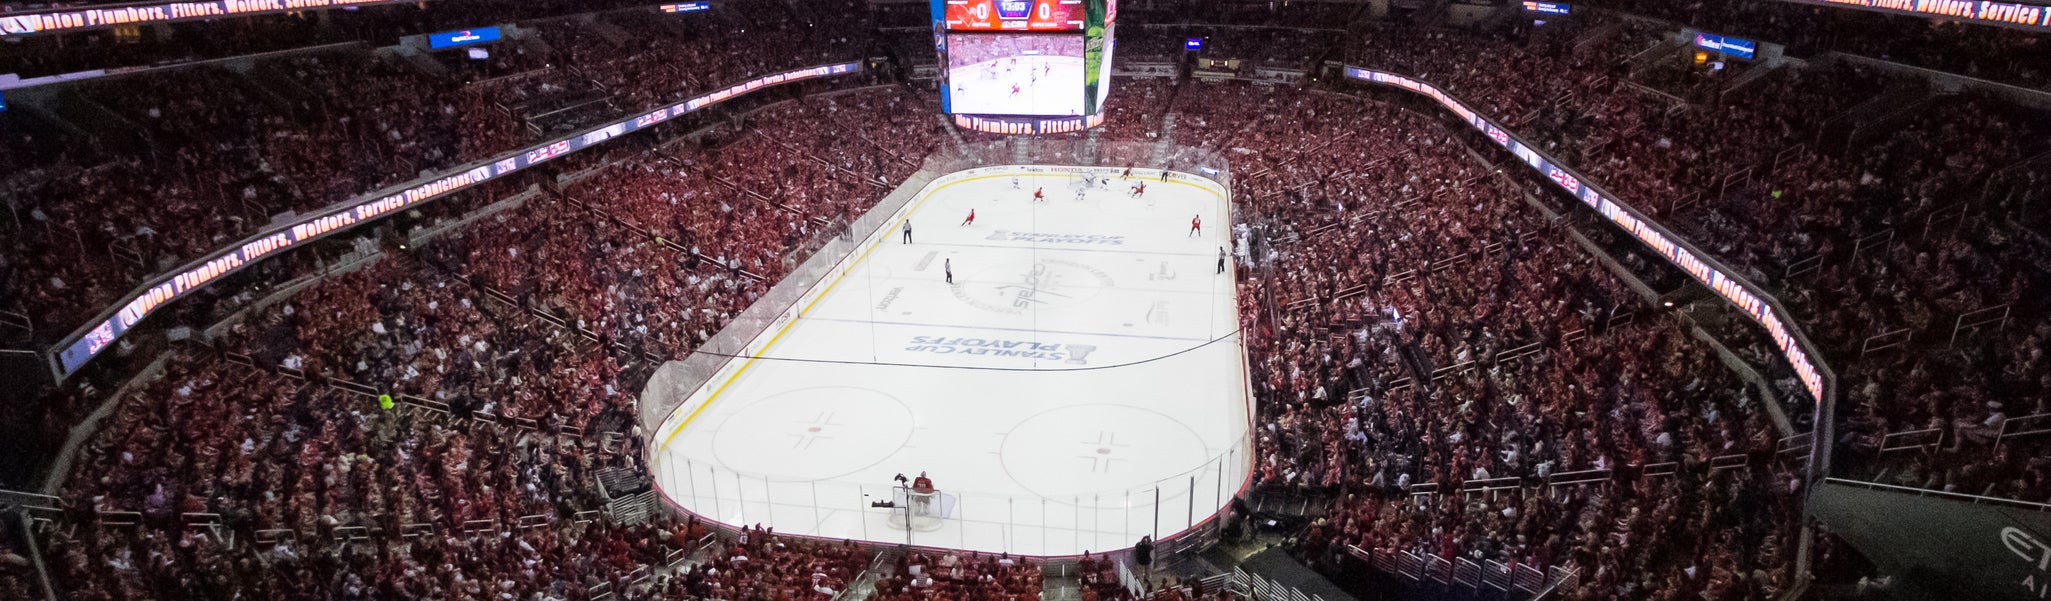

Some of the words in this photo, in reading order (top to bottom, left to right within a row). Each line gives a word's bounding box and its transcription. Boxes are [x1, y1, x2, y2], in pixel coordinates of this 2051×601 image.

[31, 13, 84, 31] Union
[86, 6, 169, 25] Plumbers,
[976, 3, 987, 19] 0
[1039, 3, 1050, 19] 0
[1979, 1, 2040, 25] Service
[2042, 6, 2051, 26] T
[973, 117, 1036, 135] Plumbers,
[1040, 119, 1084, 134] Fitters,
[174, 253, 242, 293] Plumbers,
[292, 212, 355, 240] Welders,
[356, 194, 404, 220] Service
[405, 173, 471, 203] Technicians
[1713, 270, 1761, 320] Welders,
[905, 345, 958, 354] CUP
[909, 336, 1062, 352] PLAYOFFS
[959, 347, 1065, 361] STANLEY
